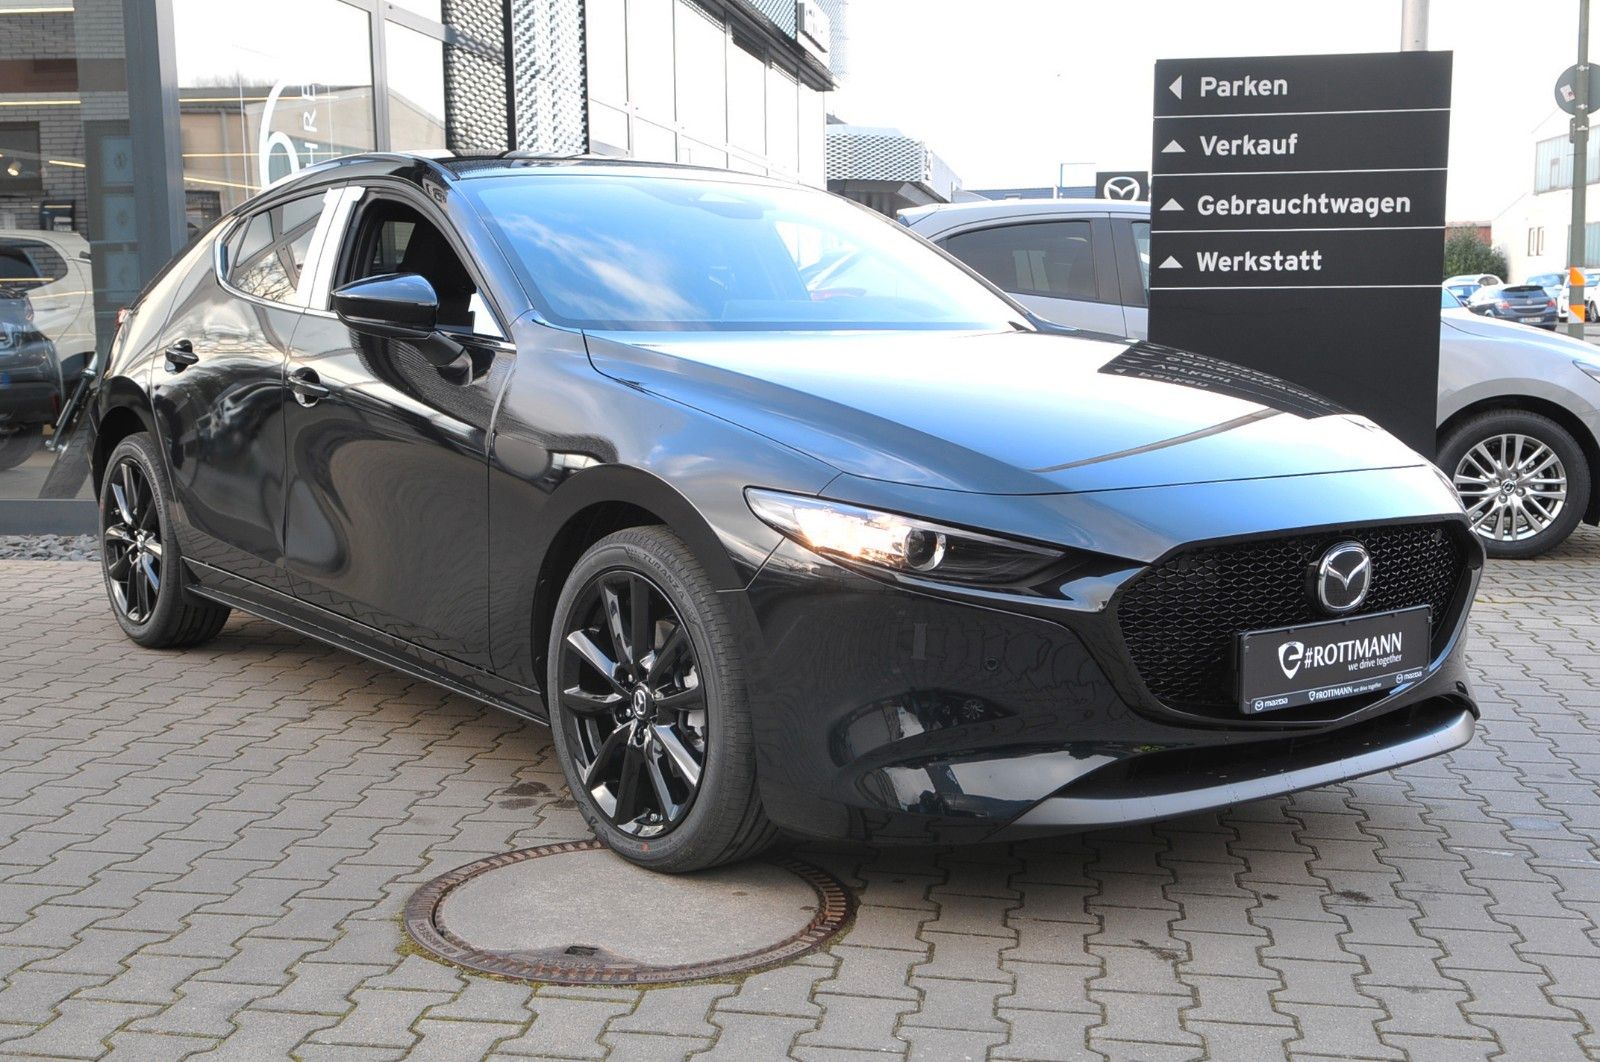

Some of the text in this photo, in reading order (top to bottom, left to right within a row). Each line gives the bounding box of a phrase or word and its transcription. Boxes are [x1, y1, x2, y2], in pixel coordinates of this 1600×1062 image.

[1200, 75, 1288, 97] Parken
[1200, 133, 1298, 156] Verkauf
[1197, 193, 1411, 219] Gebrauchtwagen
[1197, 250, 1323, 272] Werkstatt
[642, 553, 686, 599] TURANZA
[1304, 632, 1402, 669] #ROTTMANN
[1348, 653, 1402, 671] we drive together
[1404, 670, 1423, 680] mazda
[1265, 697, 1288, 707] mazda
